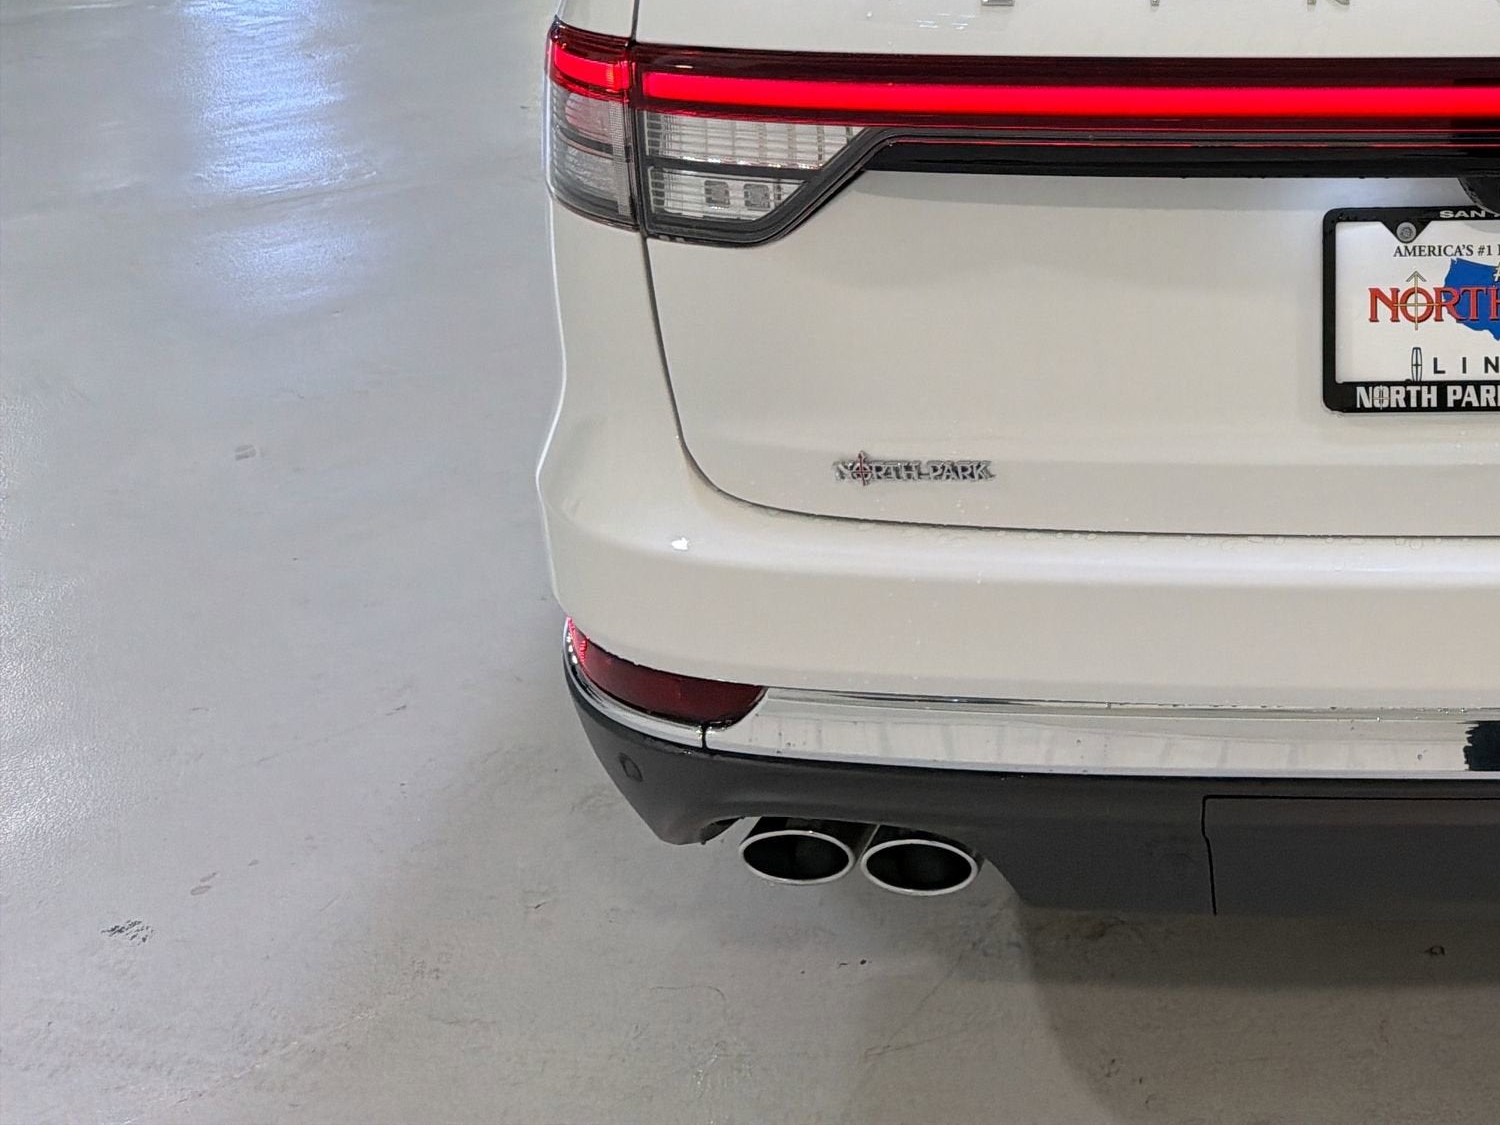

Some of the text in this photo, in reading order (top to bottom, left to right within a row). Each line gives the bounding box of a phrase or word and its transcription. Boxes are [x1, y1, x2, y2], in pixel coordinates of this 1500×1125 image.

[1439, 210, 1485, 219] SAN
[1393, 243, 1473, 257] AMERICA'S
[1477, 244, 1492, 256] #1
[1356, 385, 1438, 409] NORTH
[833, 460, 994, 481] NORTH PARK
